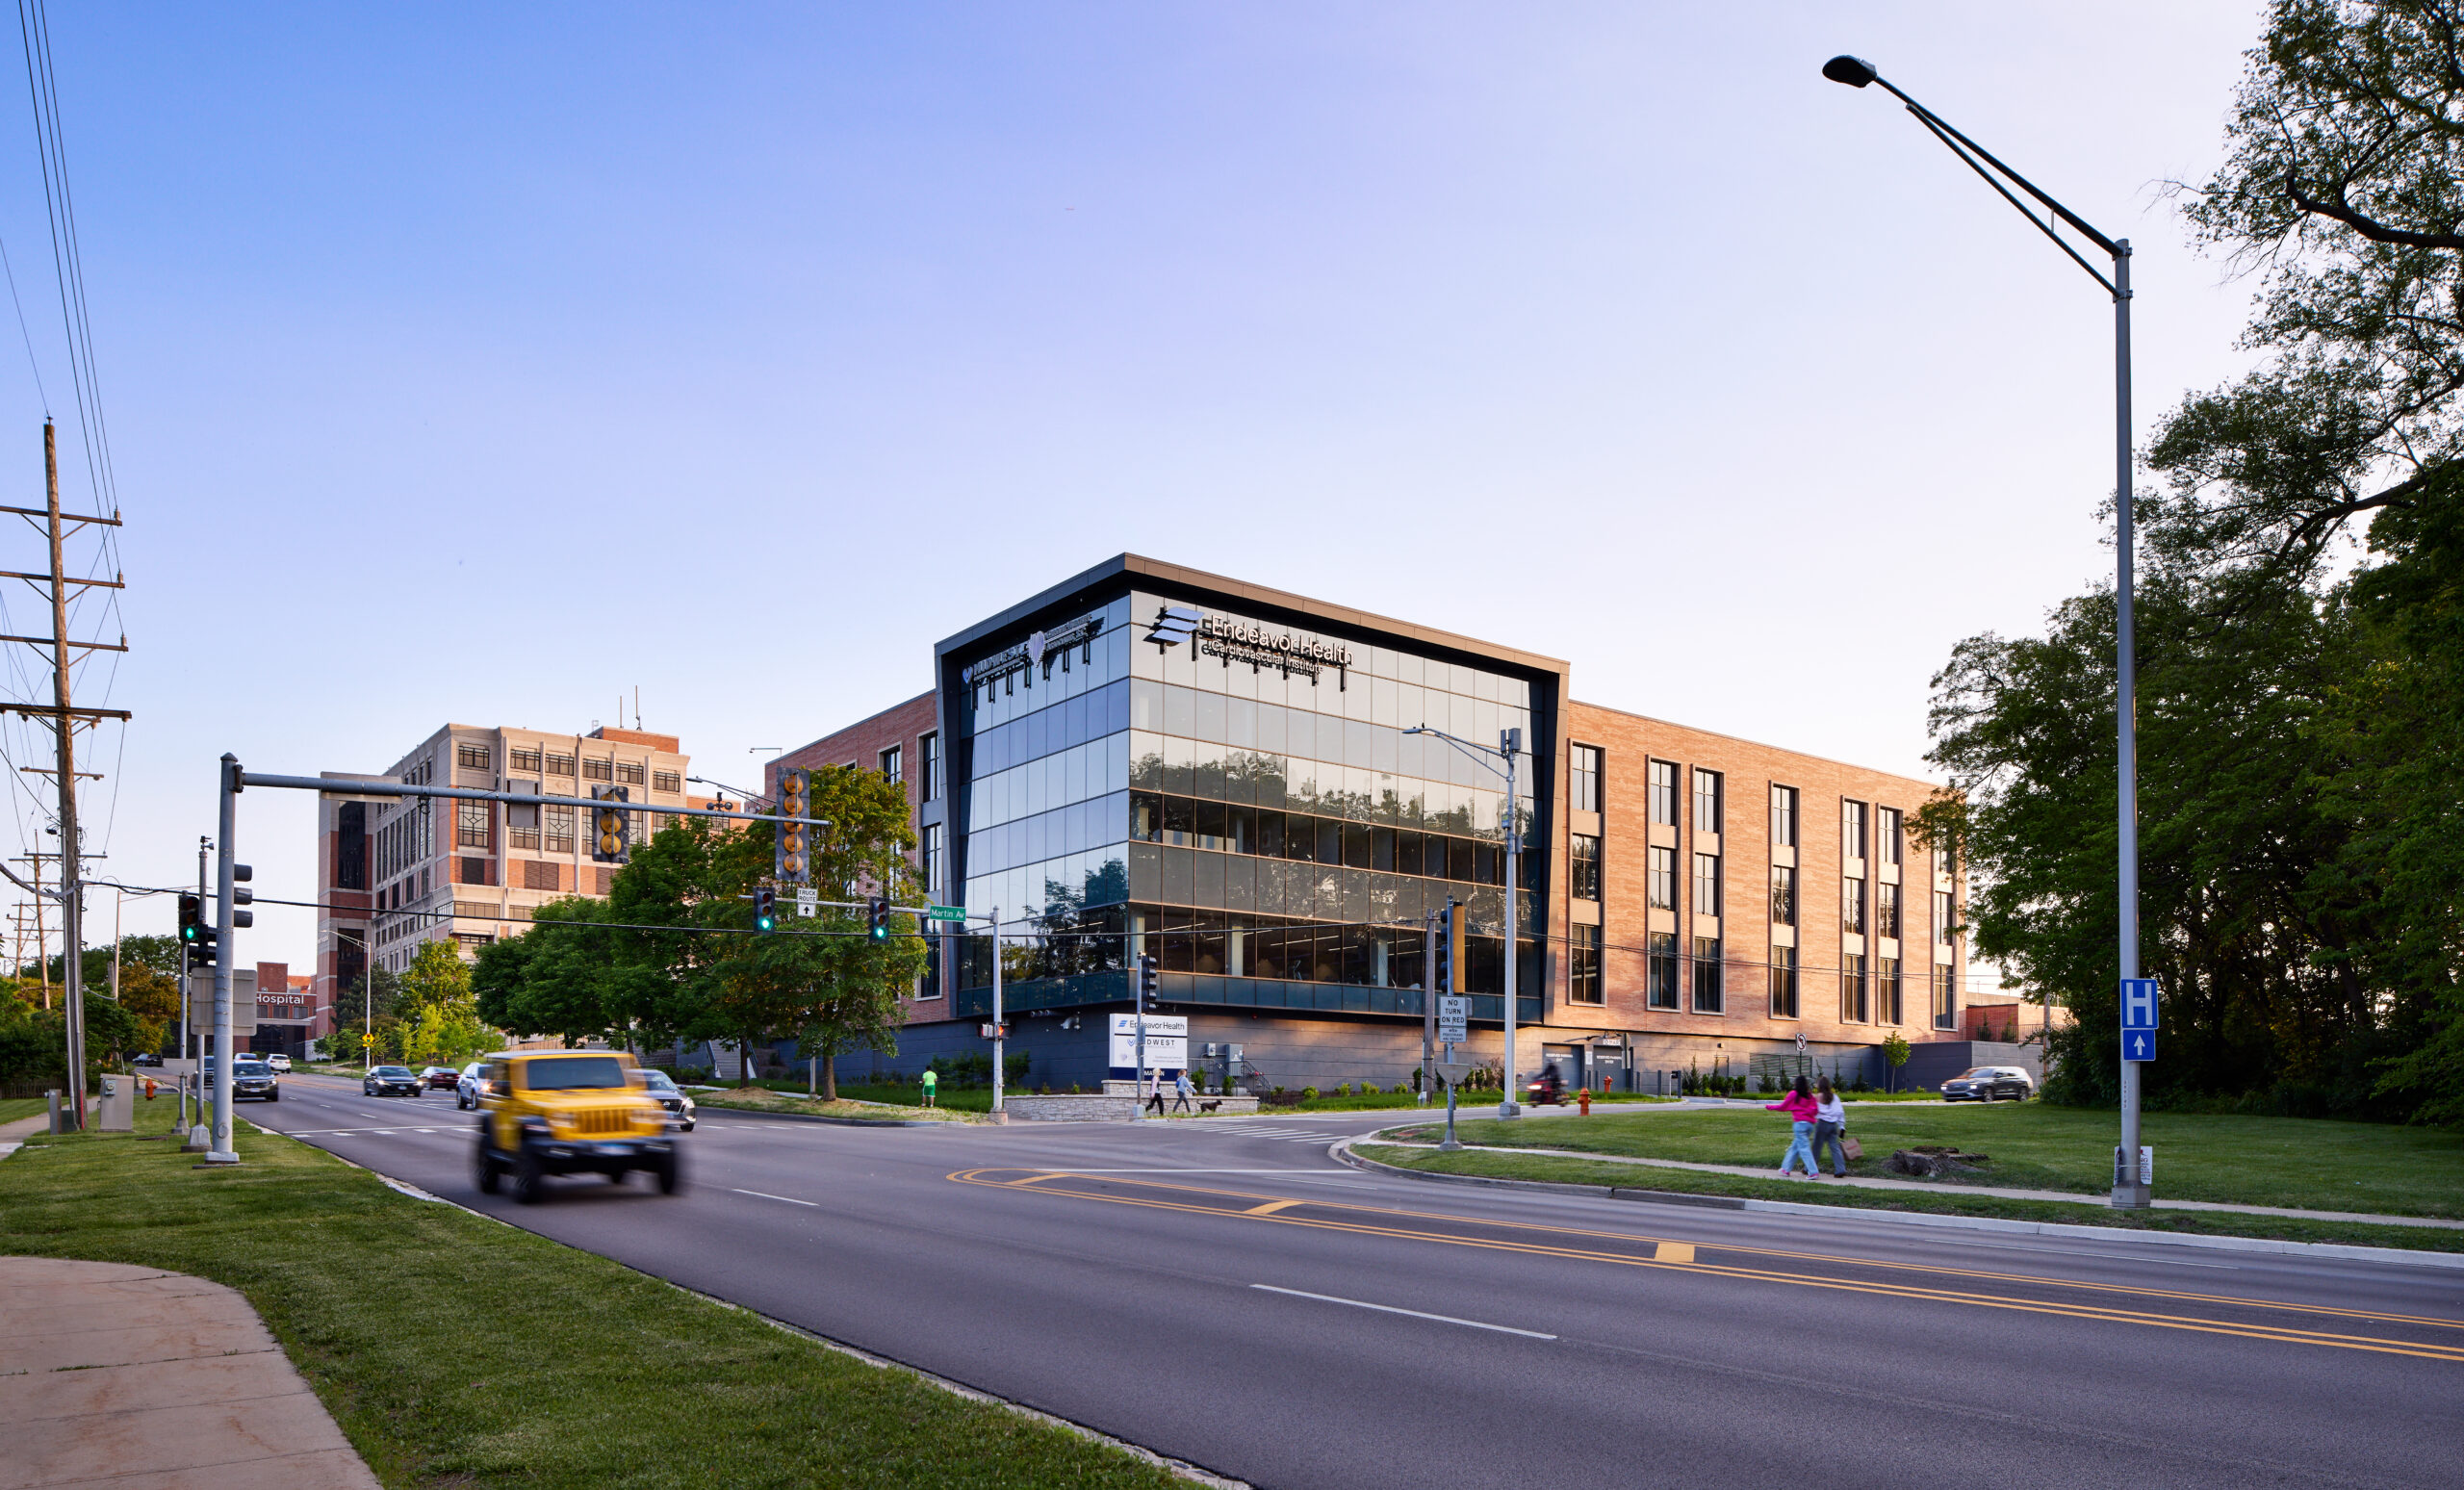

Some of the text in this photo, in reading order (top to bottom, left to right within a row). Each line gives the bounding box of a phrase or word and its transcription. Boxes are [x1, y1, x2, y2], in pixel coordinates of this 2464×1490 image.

[1212, 615, 1353, 665] Endeavor Health
[1212, 640, 1323, 674] Cardiovascular Institute
[931, 909, 964, 919] Martin Av
[256, 993, 304, 1005] Hospital
[2126, 983, 2153, 1025] H
[1163, 1021, 1185, 1030] Health
